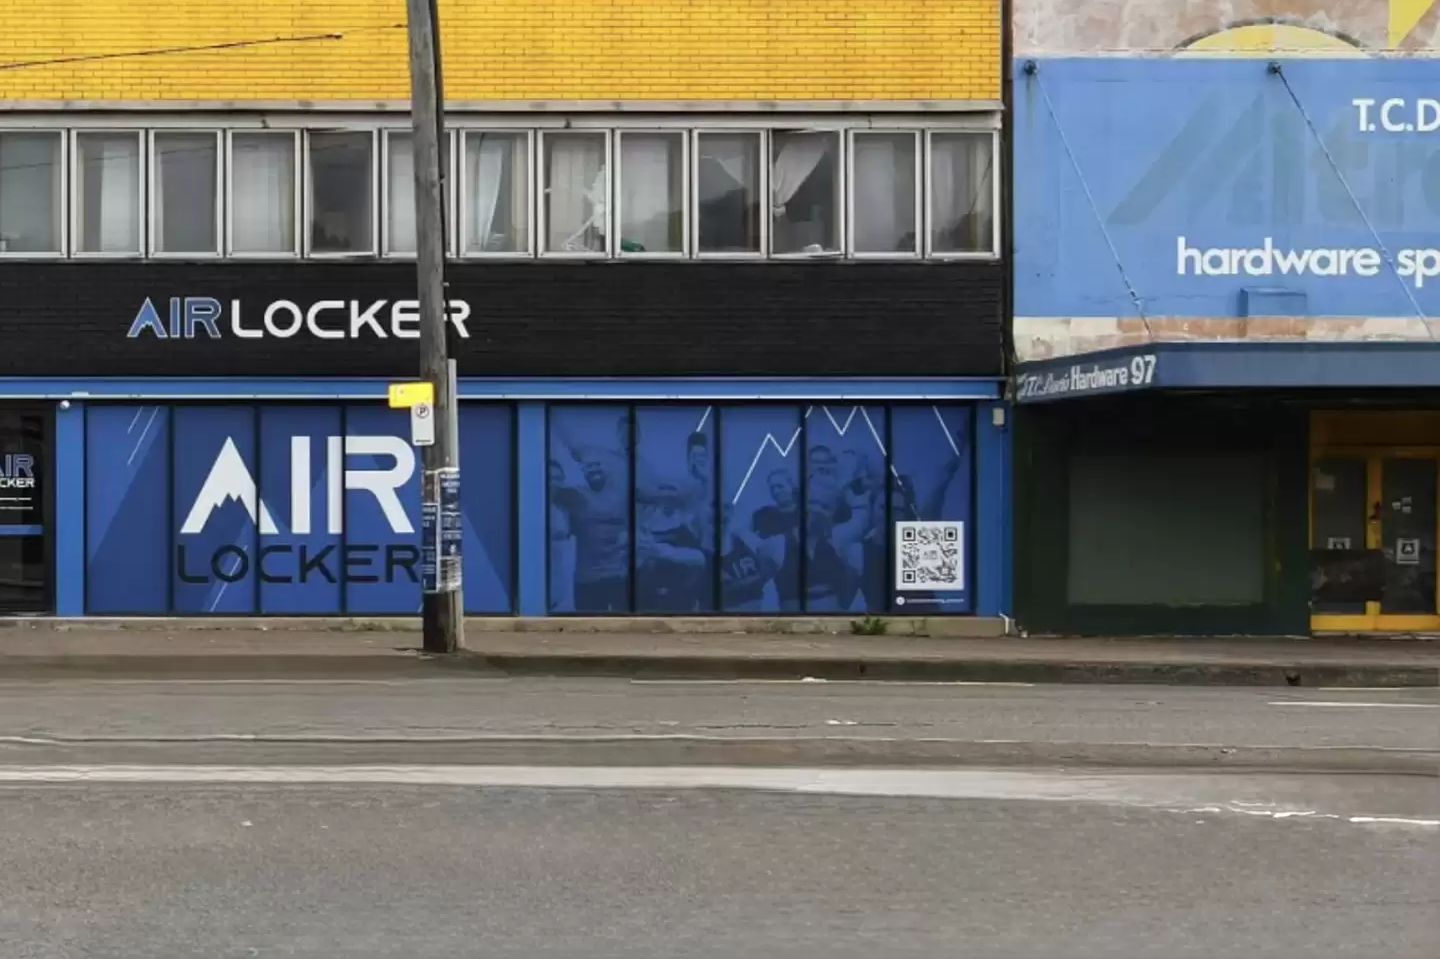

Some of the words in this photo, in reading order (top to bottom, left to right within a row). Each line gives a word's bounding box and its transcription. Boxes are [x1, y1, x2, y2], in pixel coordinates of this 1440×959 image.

[1352, 98, 1440, 132] T.C.D
[1177, 236, 1380, 276] hardware
[1397, 248, 1440, 288] sp
[127, 297, 221, 338] AIR
[231, 299, 471, 338] LOCKER
[1070, 365, 1128, 391] Hardware
[1131, 355, 1157, 385] 97
[180, 436, 415, 534] AIR
[177, 544, 420, 583] LOCKER
